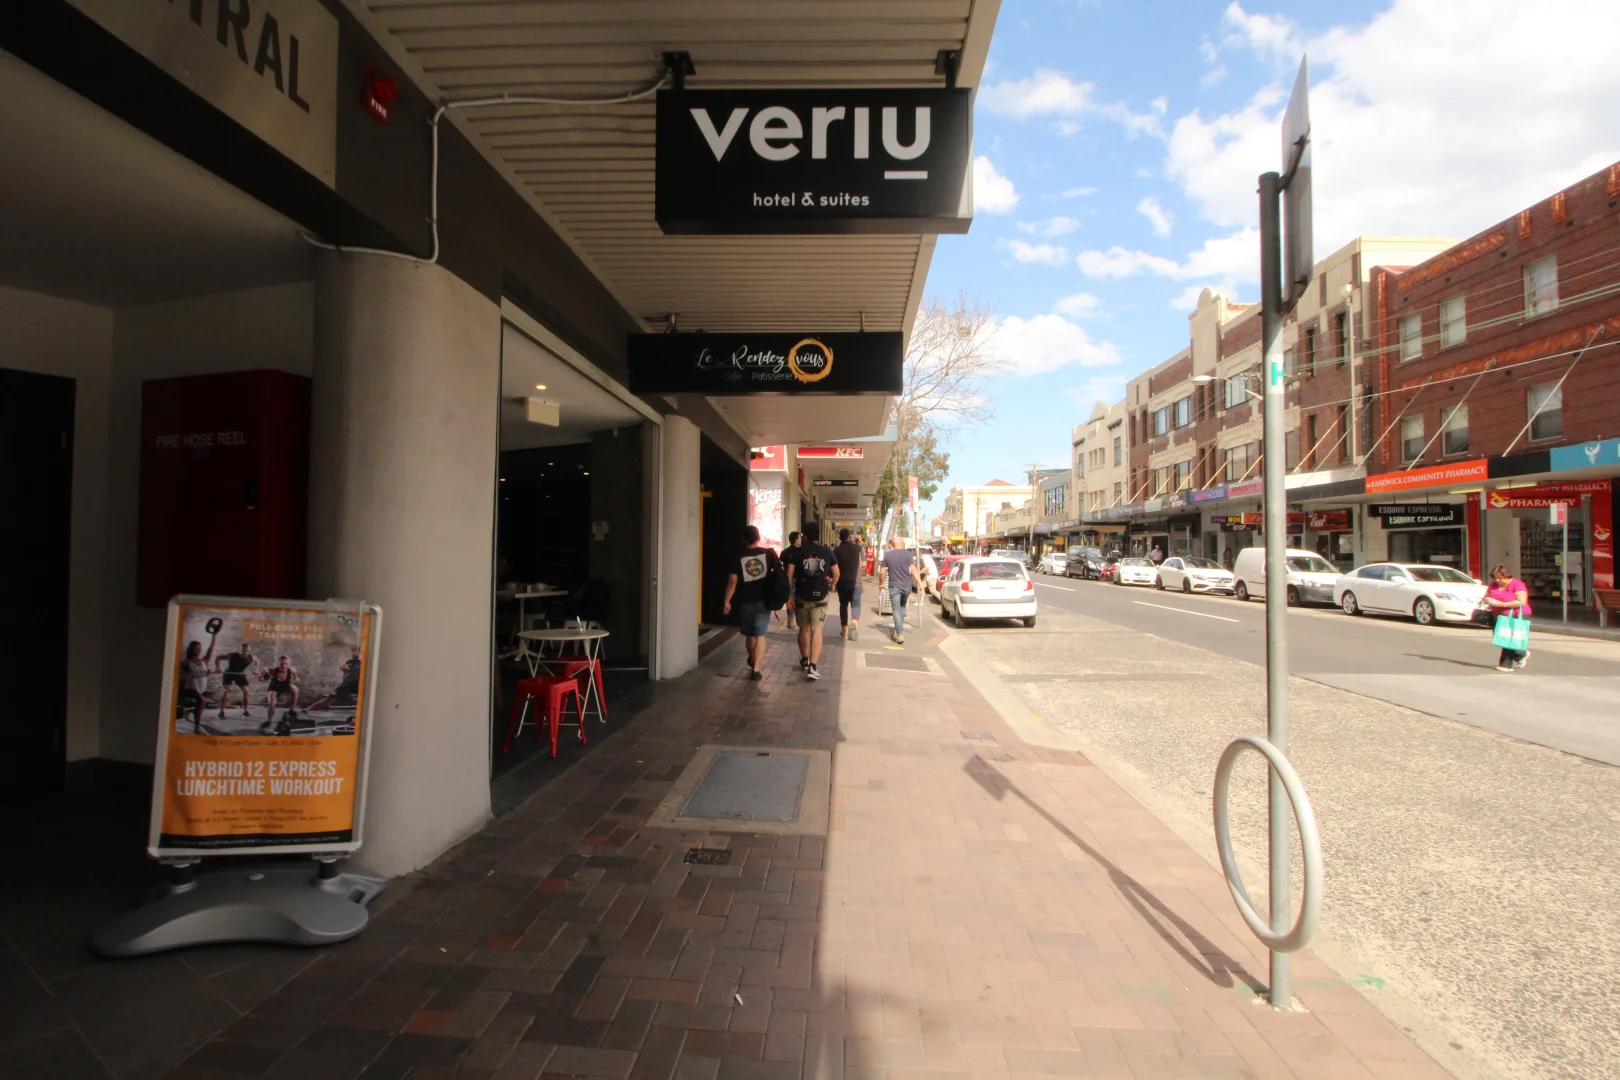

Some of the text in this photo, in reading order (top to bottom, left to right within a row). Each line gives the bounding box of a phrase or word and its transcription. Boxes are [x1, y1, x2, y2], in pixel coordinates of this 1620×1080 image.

[371, 98, 388, 118] FIRE
[753, 191, 870, 207] hotel & suites
[695, 344, 825, 373] Le Rendez vous
[751, 371, 794, 381] Patisserie
[156, 430, 249, 451] FIRE HOSE REEL
[835, 447, 862, 457] KFC
[1371, 465, 1486, 488] RANDWICK COMMUNITY PHARMACY
[1378, 505, 1442, 514] ESQUIRE ESPRESSO
[249, 623, 272, 631] FULL
[275, 624, 300, 632] BODY
[259, 632, 302, 640] TRAINING
[185, 760, 338, 778] HYBRID 12 EXPRESS
[176, 778, 344, 797] LUNCHTIME WORKOUT
